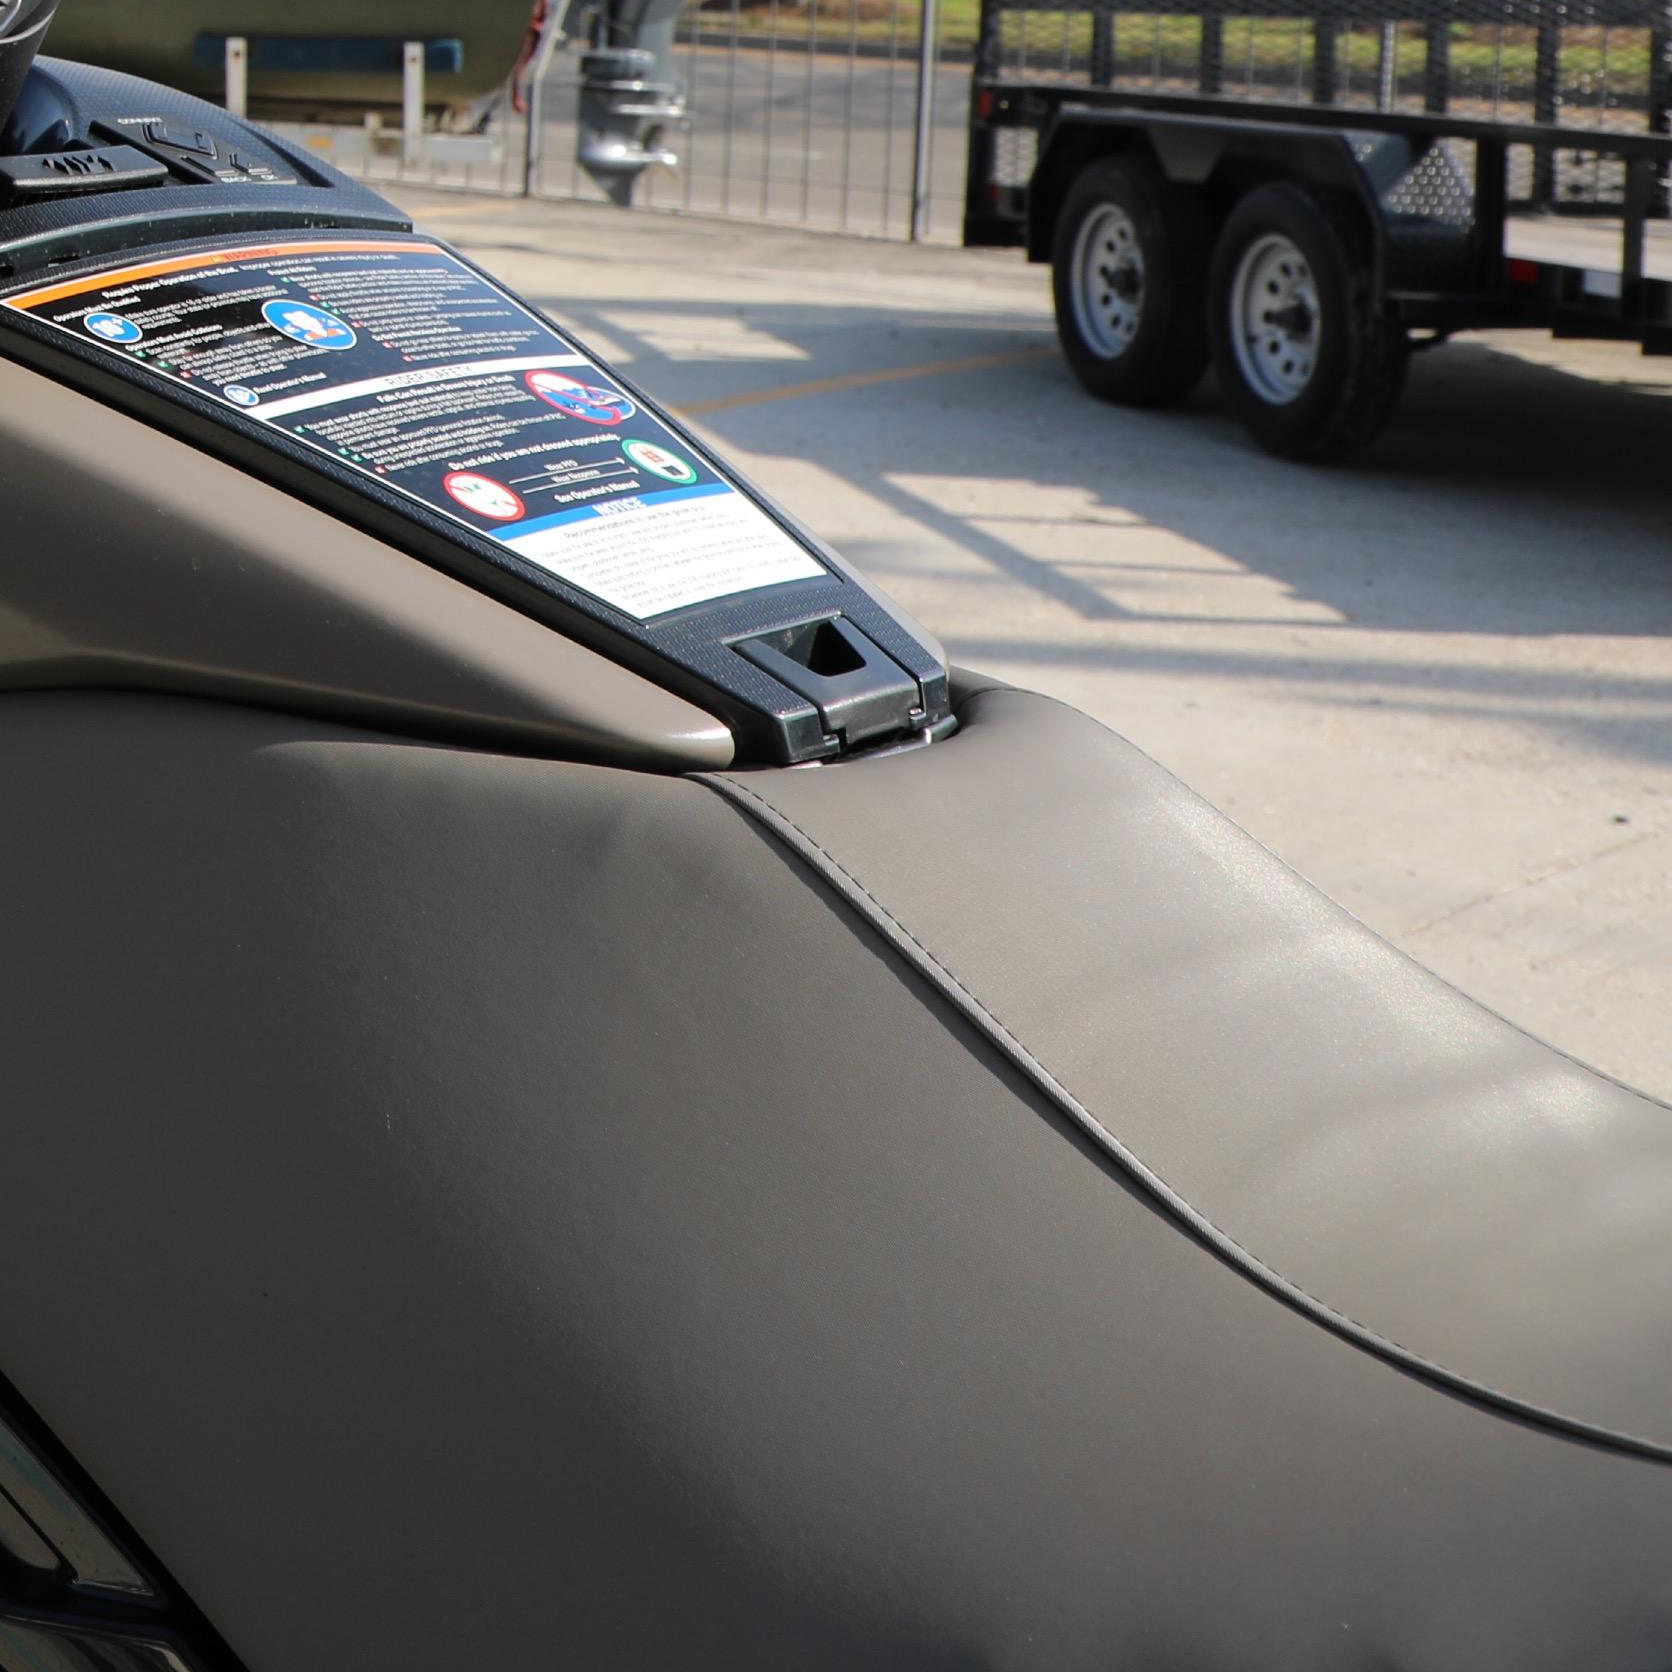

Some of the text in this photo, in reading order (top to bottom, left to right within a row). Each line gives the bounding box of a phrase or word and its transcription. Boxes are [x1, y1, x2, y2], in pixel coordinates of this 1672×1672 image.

[224, 248, 277, 260] WARNING
[132, 280, 160, 292] Proper
[159, 272, 197, 286] Operation
[92, 317, 124, 338] 16+
[253, 371, 326, 394] Read Operator's Manual
[386, 365, 472, 386] RIDER SAFETY
[376, 392, 397, 403] Falls
[395, 390, 412, 399] Can
[411, 386, 436, 396] Result
[441, 381, 466, 391] Severe
[464, 378, 486, 387] Injury
[492, 374, 514, 383] Death
[449, 461, 464, 471] Do
[462, 457, 479, 468] not
[477, 454, 494, 465] ride
[500, 449, 517, 460] you
[515, 446, 530, 456] are
[528, 444, 544, 454] not
[542, 439, 573, 451] dressed
[543, 461, 562, 471] Wear
[551, 467, 599, 483] Wear Neoprene
[554, 479, 640, 504] See Operator's Manual
[593, 495, 644, 516] NOTICE
[563, 517, 638, 538] Recommendations
